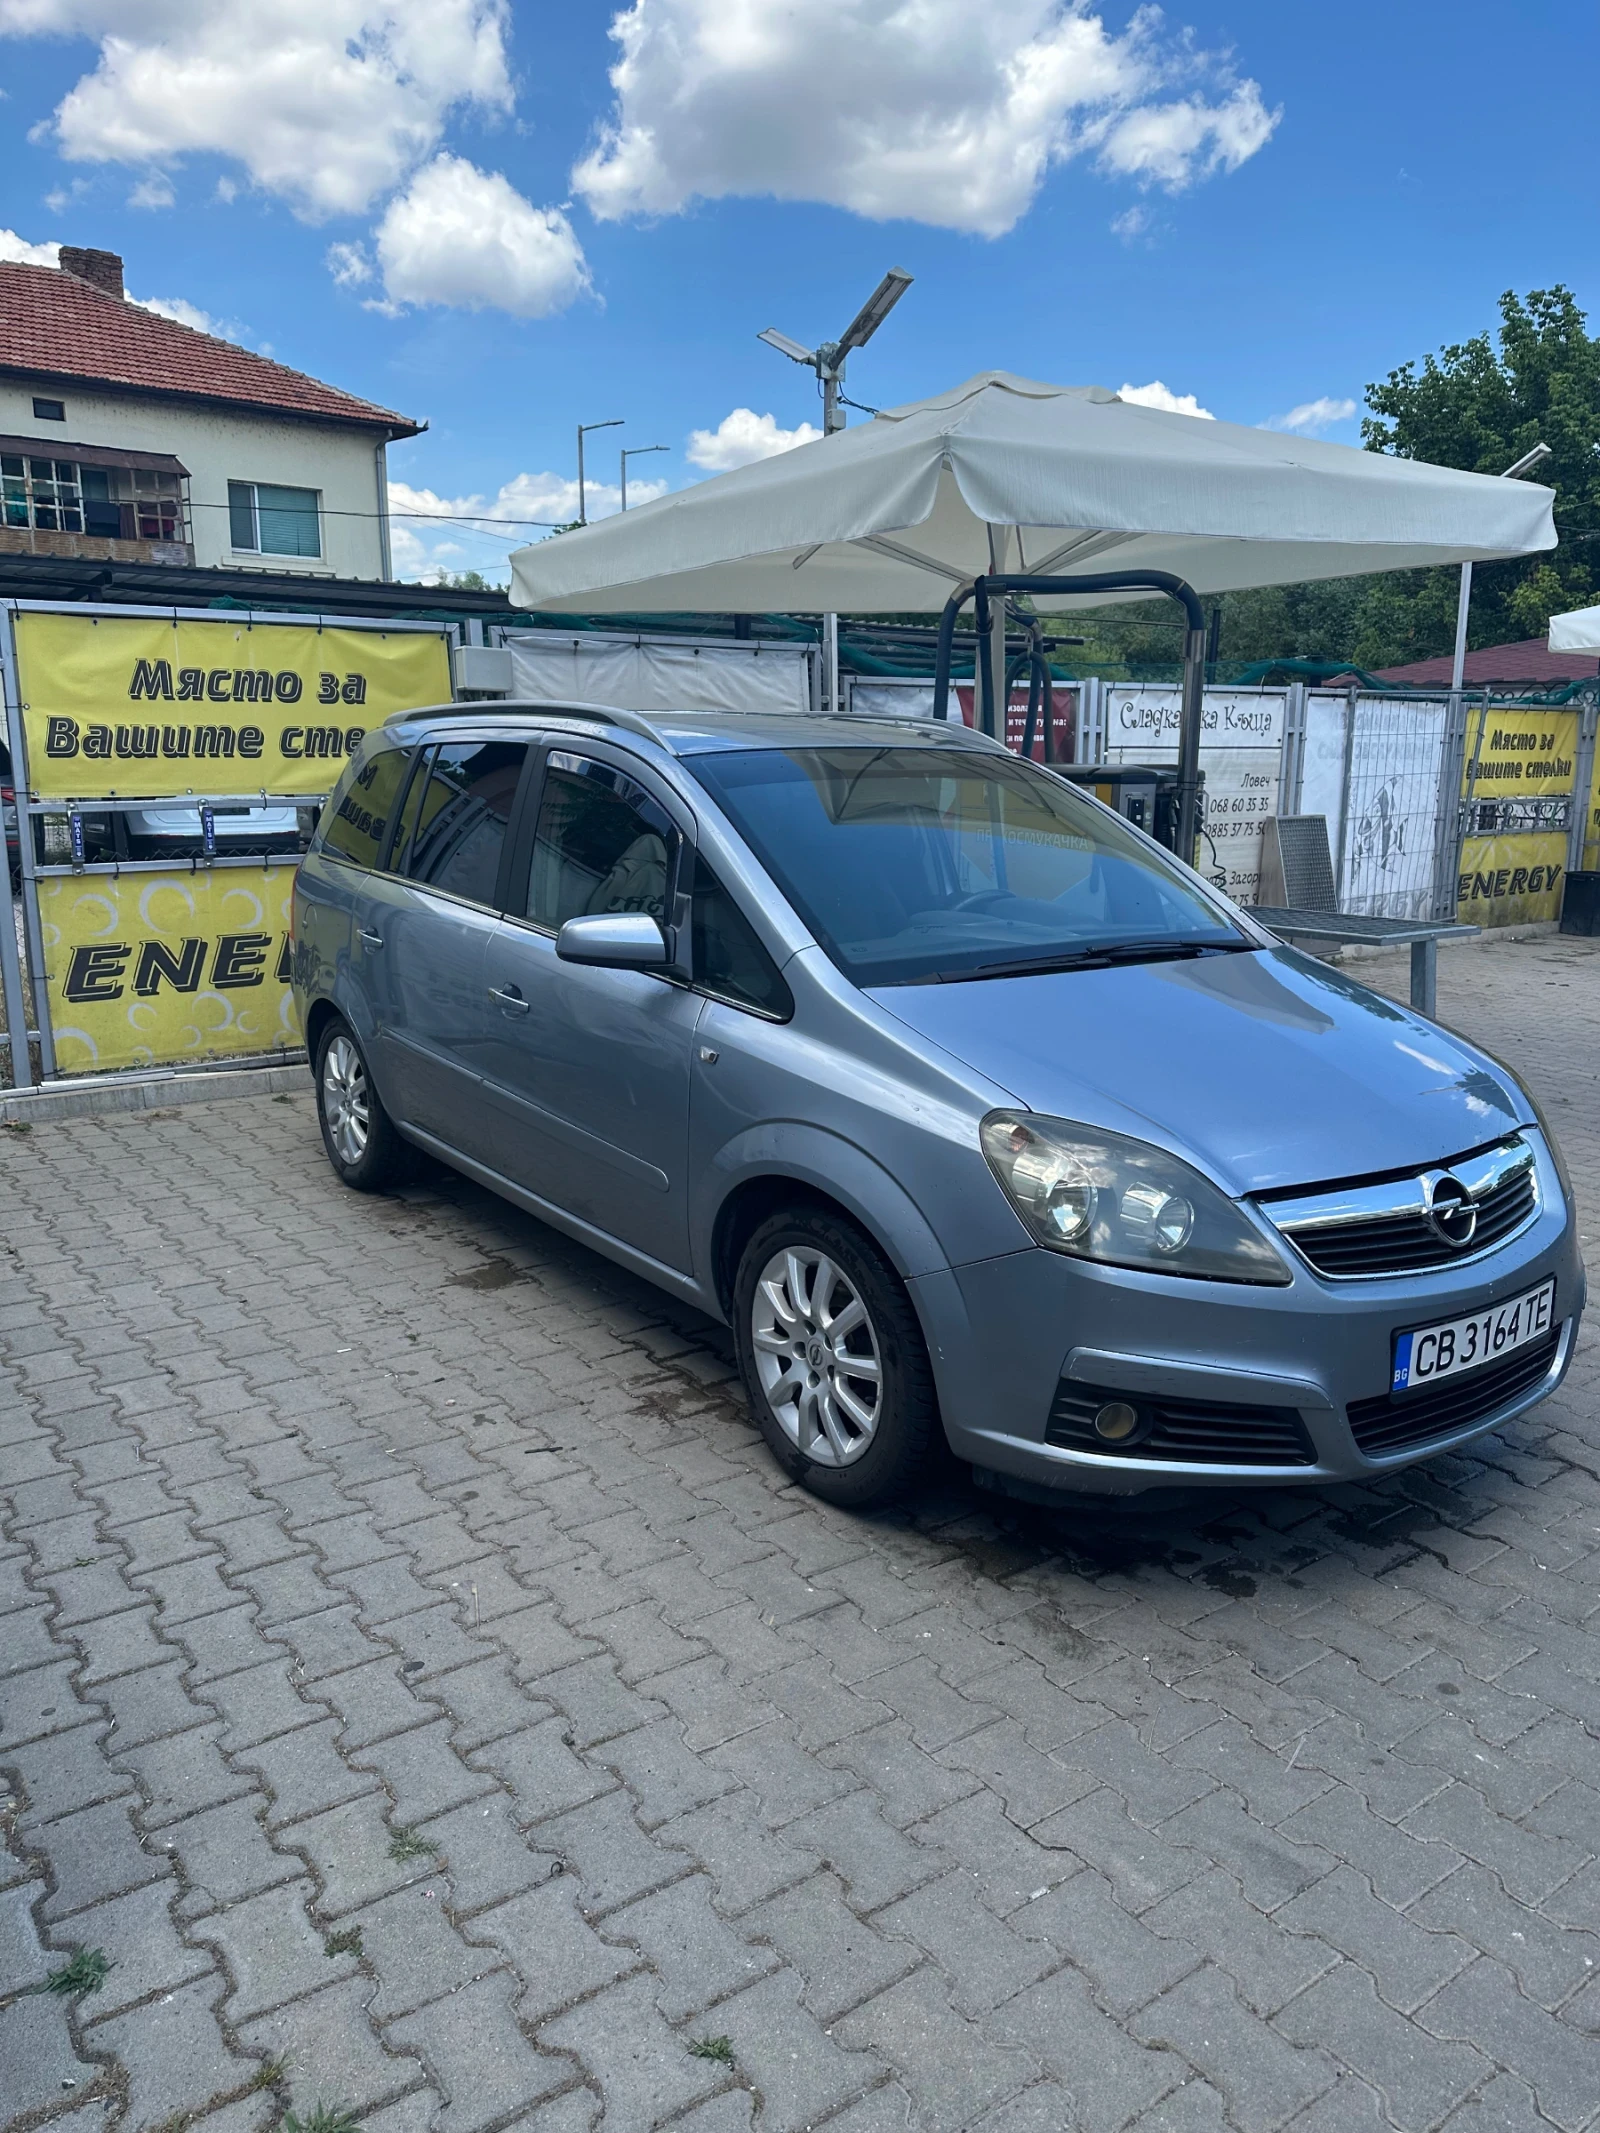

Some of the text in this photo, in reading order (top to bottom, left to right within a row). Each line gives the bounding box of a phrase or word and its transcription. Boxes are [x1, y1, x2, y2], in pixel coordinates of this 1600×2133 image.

[128, 657, 367, 704] Място за
[1224, 704, 1272, 737] Къща
[44, 715, 265, 759] Вашите
[1490, 729, 1555, 750] Място за
[1241, 773, 1270, 788] Ловеч
[1210, 797, 1269, 813] 068 60 35 35
[1230, 822, 1243, 837] 37
[1243, 821, 1254, 836] 75
[1457, 863, 1562, 902] ENERGY
[1415, 1287, 1550, 1377] CB 3164 TE
[1394, 1367, 1408, 1383] BG
